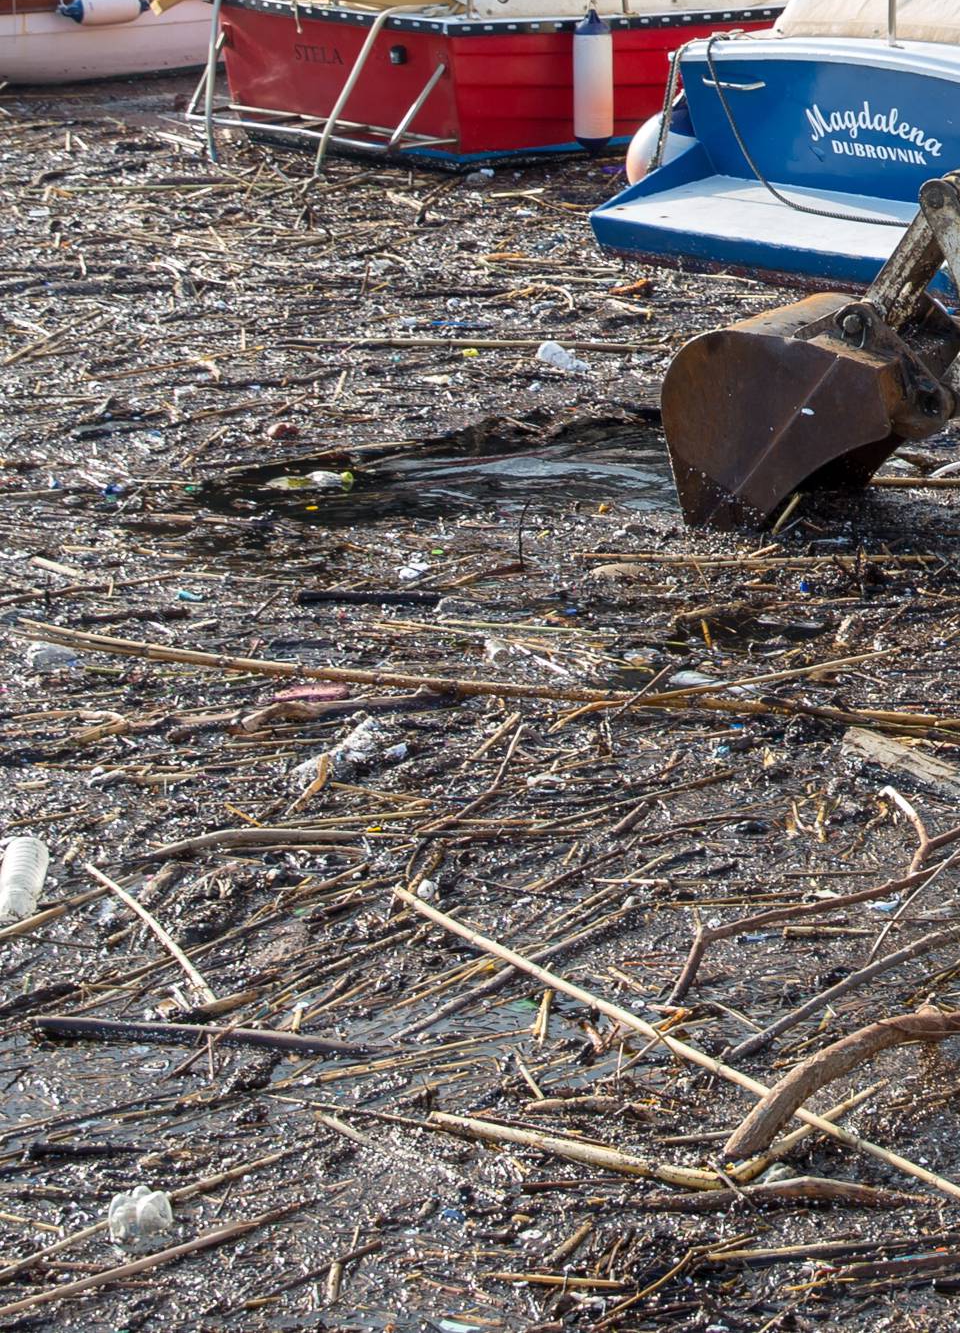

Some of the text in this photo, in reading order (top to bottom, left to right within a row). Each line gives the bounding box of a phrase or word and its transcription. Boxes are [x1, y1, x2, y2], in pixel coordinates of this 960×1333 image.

[294, 43, 344, 65] STELA
[806, 101, 943, 157] Magdalena
[831, 139, 928, 166] DUBROVNIK
